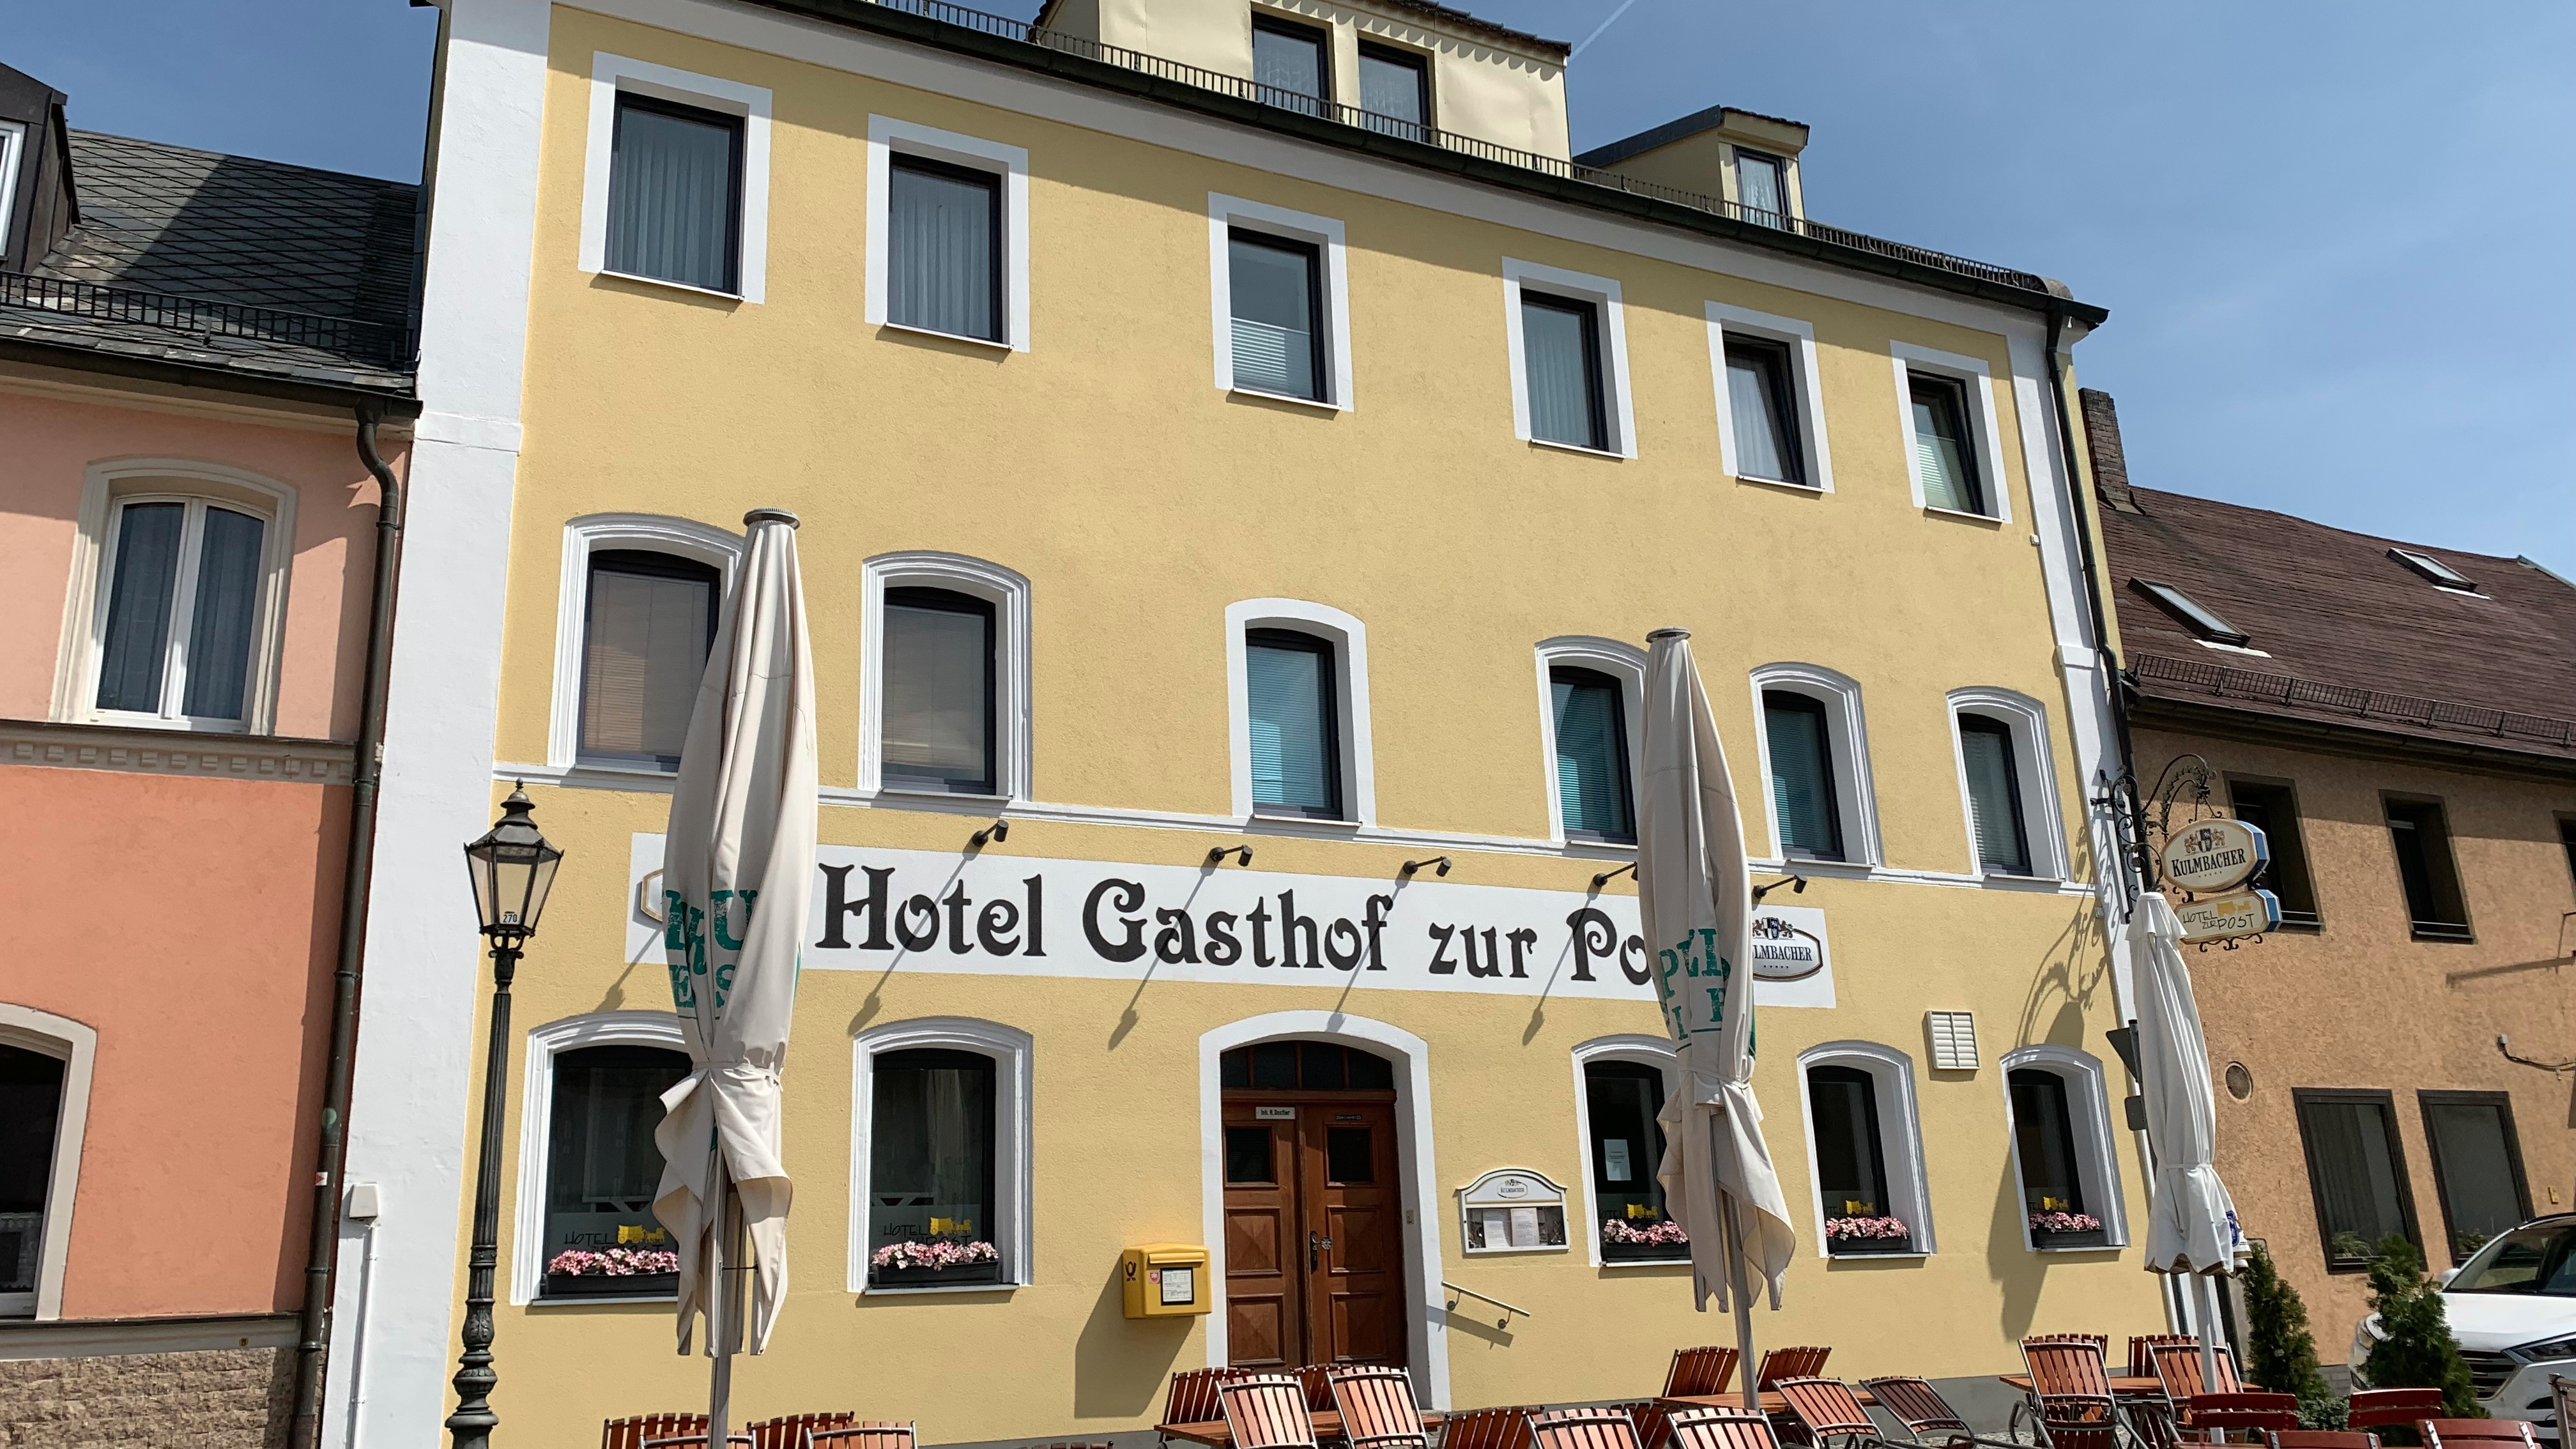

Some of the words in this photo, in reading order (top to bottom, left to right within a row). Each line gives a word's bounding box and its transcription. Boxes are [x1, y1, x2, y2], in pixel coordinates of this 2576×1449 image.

[2172, 848, 2246, 877] KULMBACHER
[503, 914, 518, 923] 270
[815, 862, 1047, 957] Hotel
[1082, 878, 1393, 971] Gasthof
[1428, 922, 1537, 978] zur
[1566, 907, 1653, 985] Po
[2182, 910, 2218, 924] HOTEL
[2218, 914, 2255, 931] POST
[1752, 944, 1813, 961] LMBACHER
[564, 1231, 615, 1246] HOTEL
[883, 1223, 928, 1238] HOTEL
